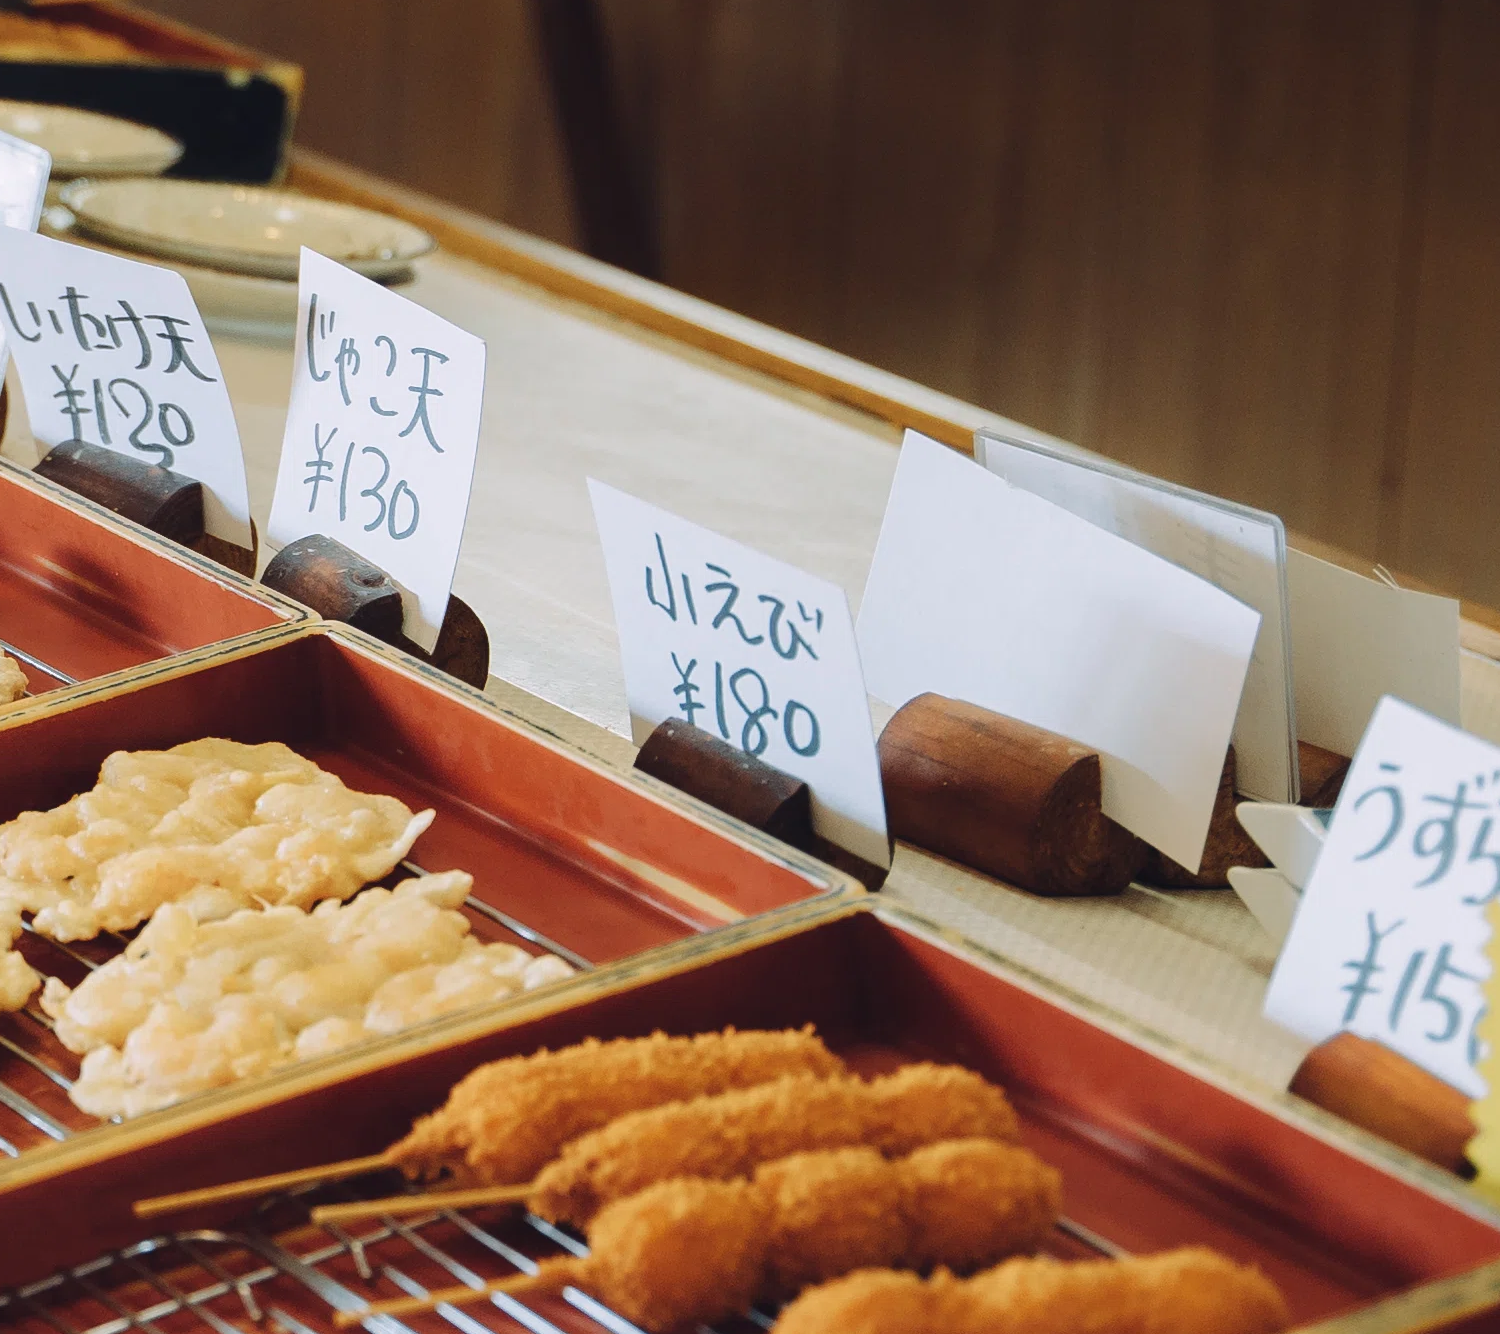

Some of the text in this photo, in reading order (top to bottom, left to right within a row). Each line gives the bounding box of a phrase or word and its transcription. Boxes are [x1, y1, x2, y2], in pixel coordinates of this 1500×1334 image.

[51, 363, 195, 468] ¥120
[305, 293, 450, 454] じゃこ天
[302, 423, 420, 541] ¥130
[645, 532, 824, 660] 小えび
[671, 652, 821, 757] ¥180
[1340, 912, 1489, 1065] ¥15
